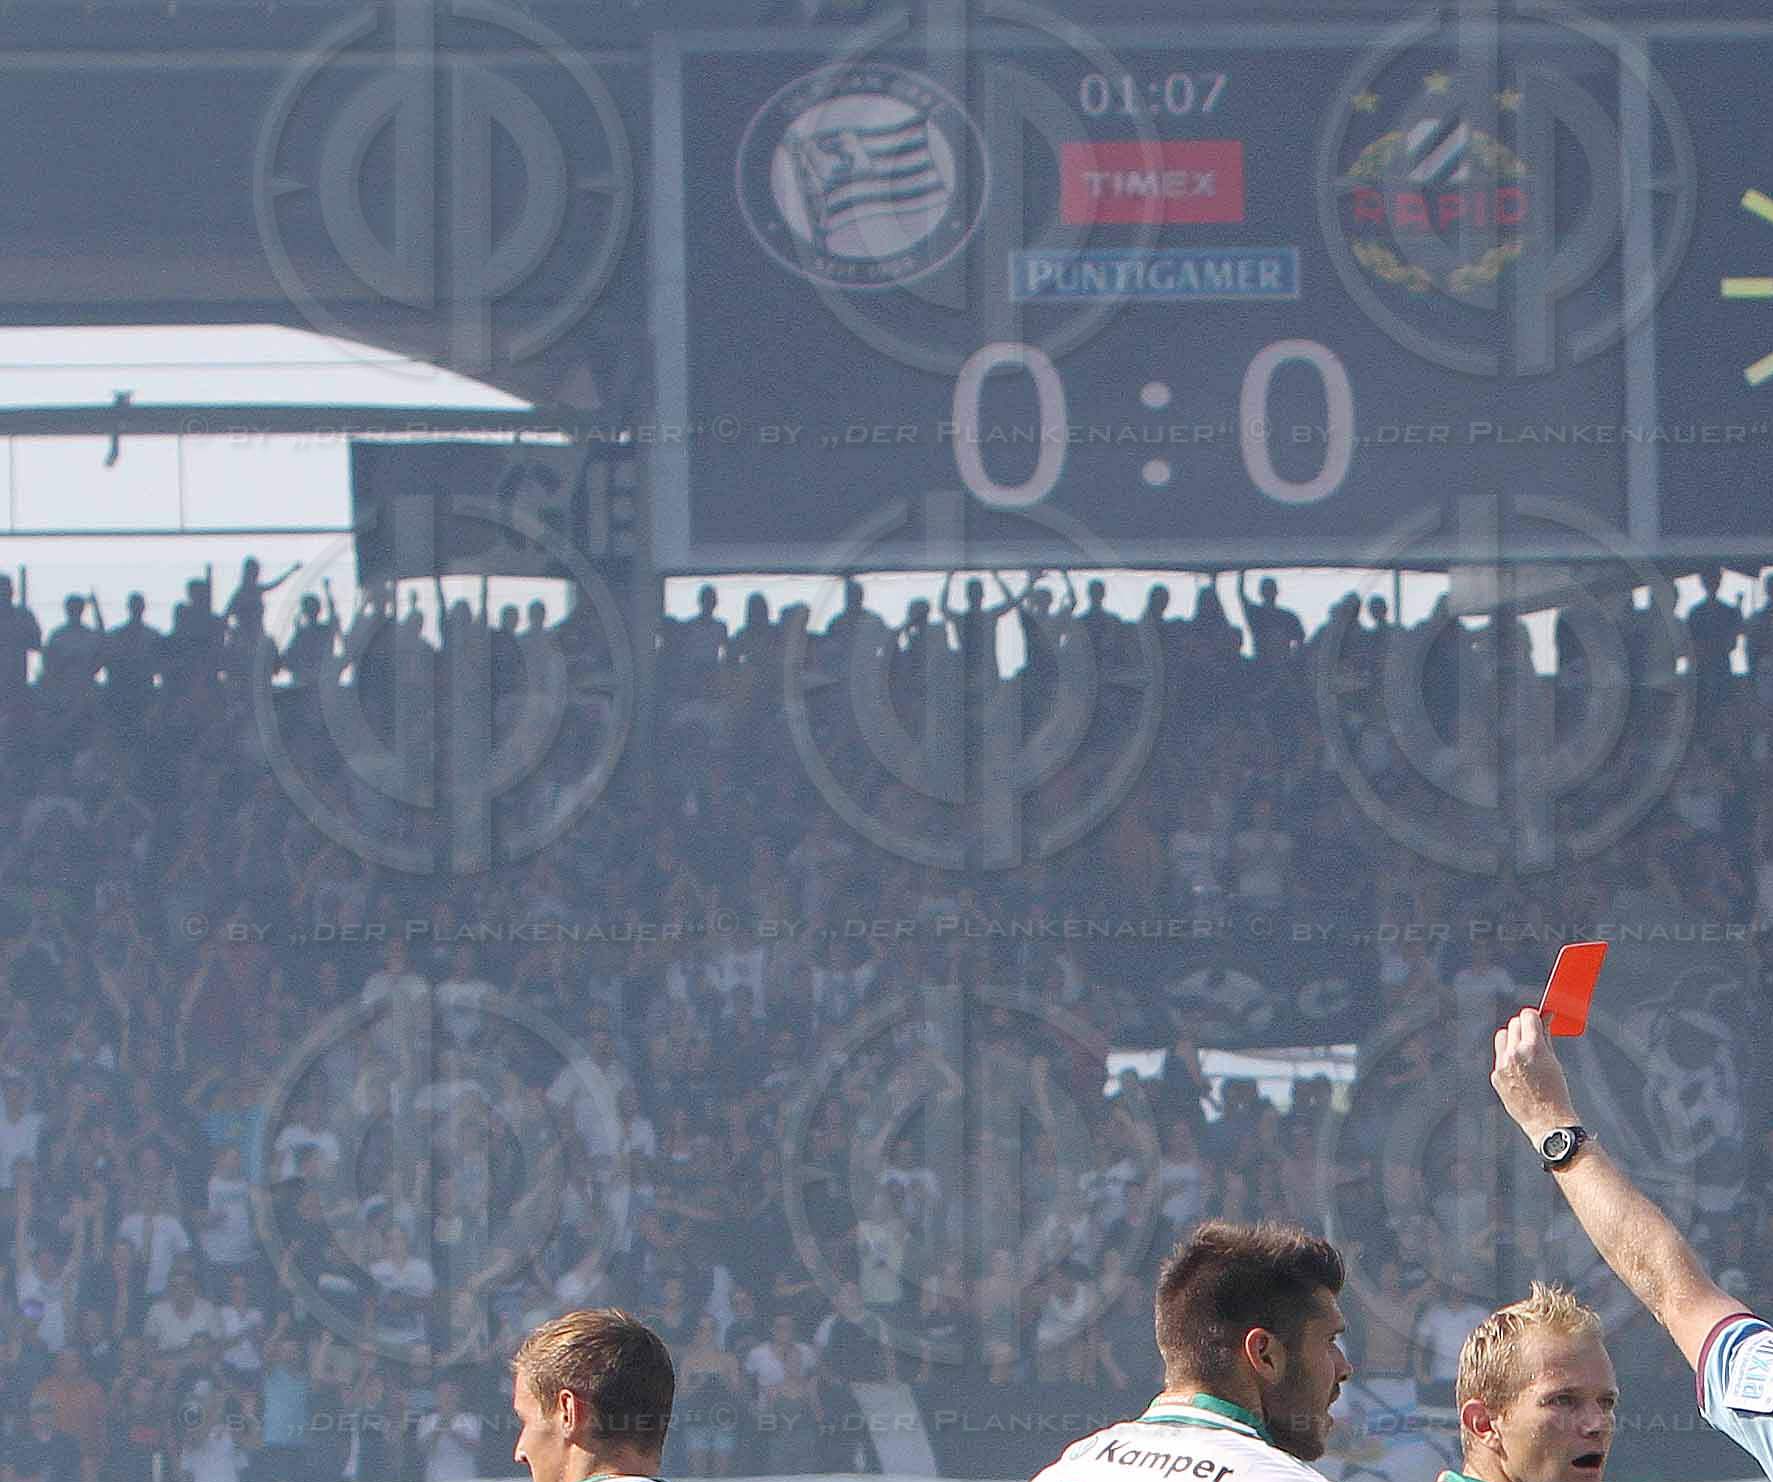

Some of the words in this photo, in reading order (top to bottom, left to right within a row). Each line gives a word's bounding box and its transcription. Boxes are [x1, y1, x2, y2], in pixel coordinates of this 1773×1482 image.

[1079, 73, 1229, 114] 01:07
[1084, 171, 1217, 197] TIMEX
[1027, 257, 1283, 291] PUNTIGAMER
[952, 341, 1069, 507] 0
[1239, 339, 1355, 504] 0
